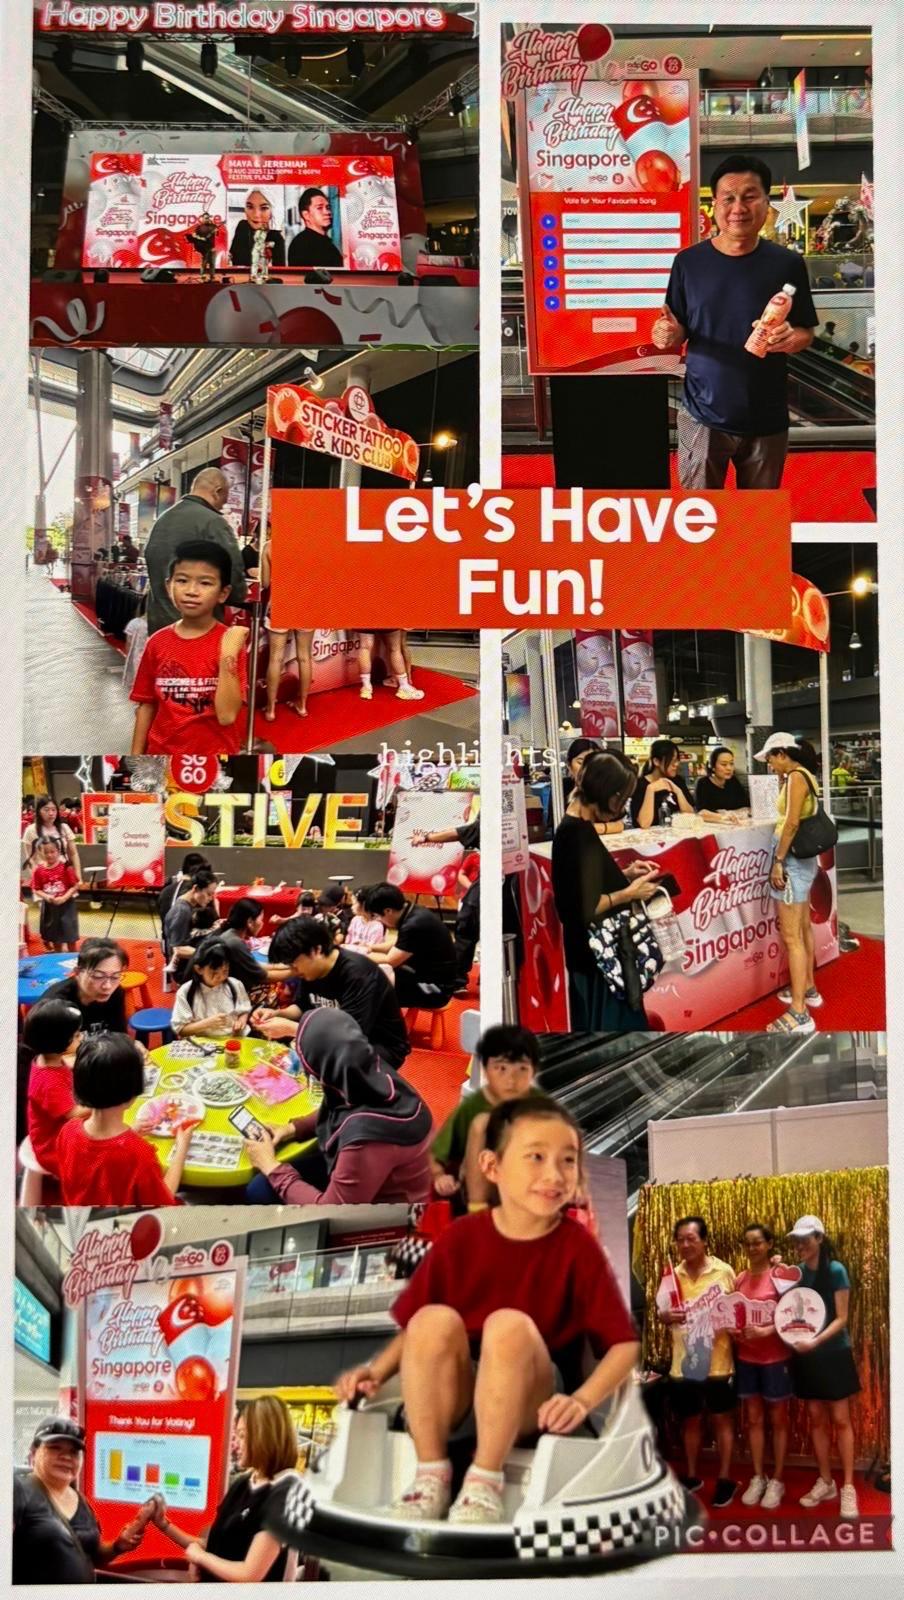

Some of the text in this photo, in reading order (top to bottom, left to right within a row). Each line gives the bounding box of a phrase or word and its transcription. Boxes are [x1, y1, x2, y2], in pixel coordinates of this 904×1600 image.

[43, 1, 443, 33] Happy Birthday Singapore
[507, 29, 579, 63] Happy
[501, 57, 588, 97] Birthday
[553, 96, 616, 123] Happy
[543, 120, 622, 151] Birthday
[228, 160, 253, 168] MAYA
[262, 160, 308, 168] JEREMIAH
[536, 150, 631, 170] Singapore
[161, 171, 213, 191] Happy
[152, 188, 217, 213] Birthday
[564, 197, 657, 206] Vote for Your Favourite Song
[302, 404, 401, 455] STICKER TATTOO
[314, 430, 393, 469] & KIDS CLUB
[179, 767, 208, 785] 60
[703, 846, 769, 886] Happy
[690, 873, 771, 931] Birthday
[71, 1229, 133, 1270] Happy
[64, 1257, 139, 1306] Birthday
[108, 1300, 163, 1330] Happy
[99, 1324, 166, 1358] Birthday
[92, 1358, 172, 1378] Singapore
[109, 1415, 196, 1431] Thank You for Voting!
